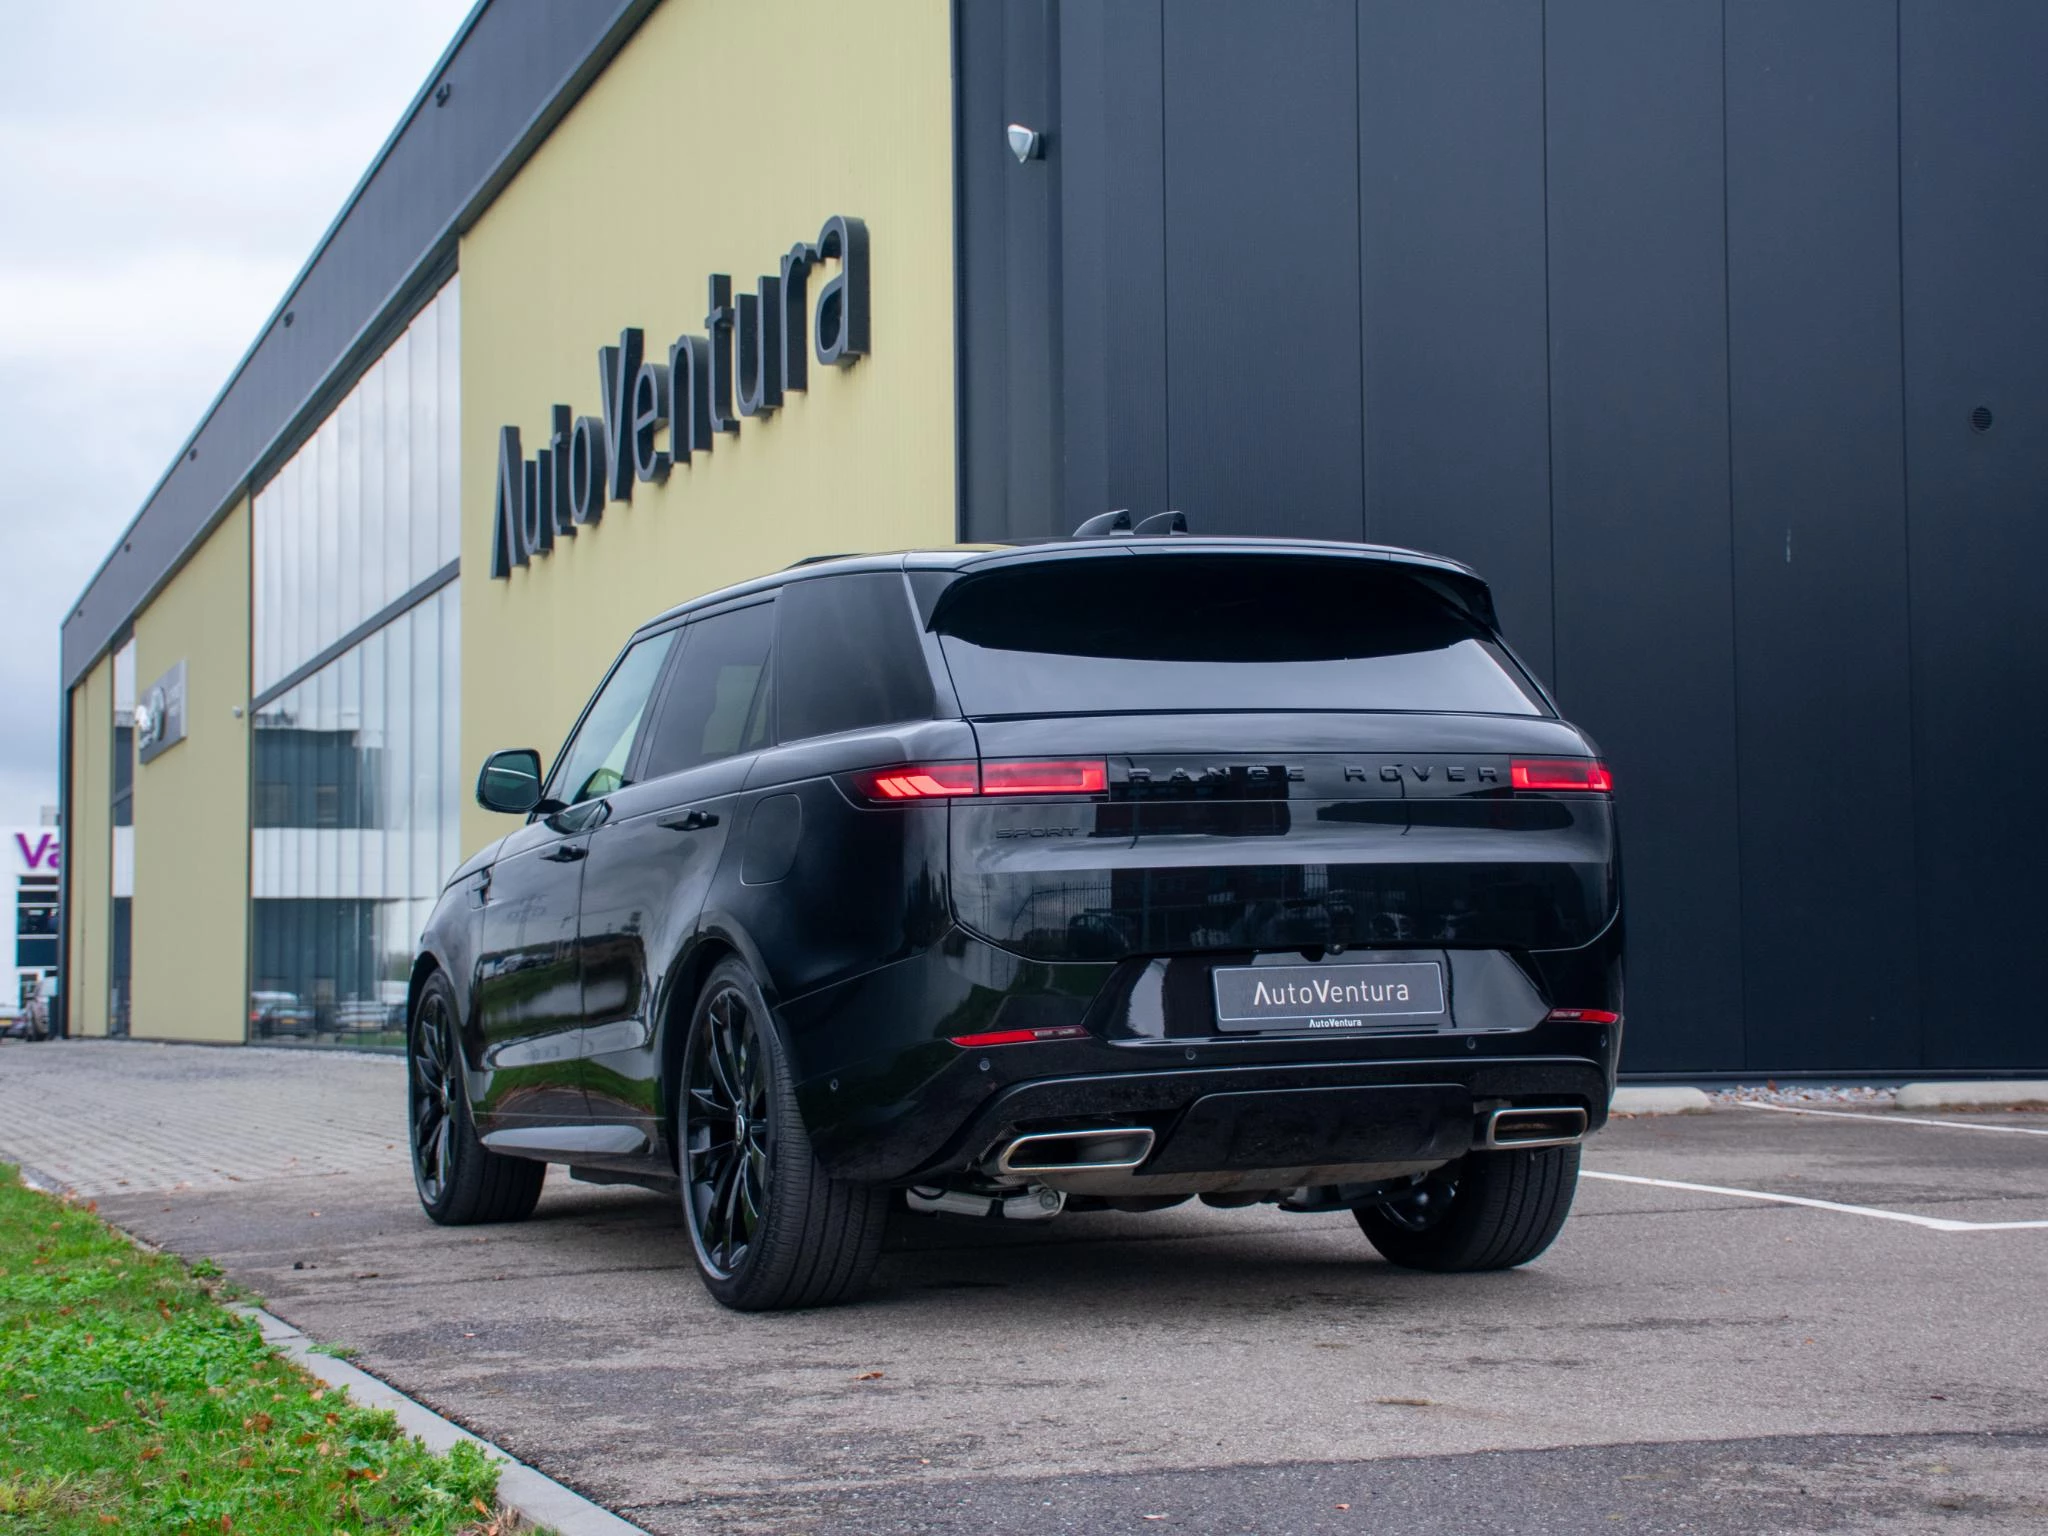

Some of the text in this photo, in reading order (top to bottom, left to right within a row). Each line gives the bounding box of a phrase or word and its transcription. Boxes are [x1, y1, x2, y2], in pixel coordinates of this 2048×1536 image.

[490, 215, 870, 579] AutoVentura
[1128, 765, 1499, 785] RANGE ROVER
[995, 825, 1080, 839] SPORT
[1253, 979, 1410, 1006] AutoVentura
[1309, 1017, 1363, 1029] AutoVentura
